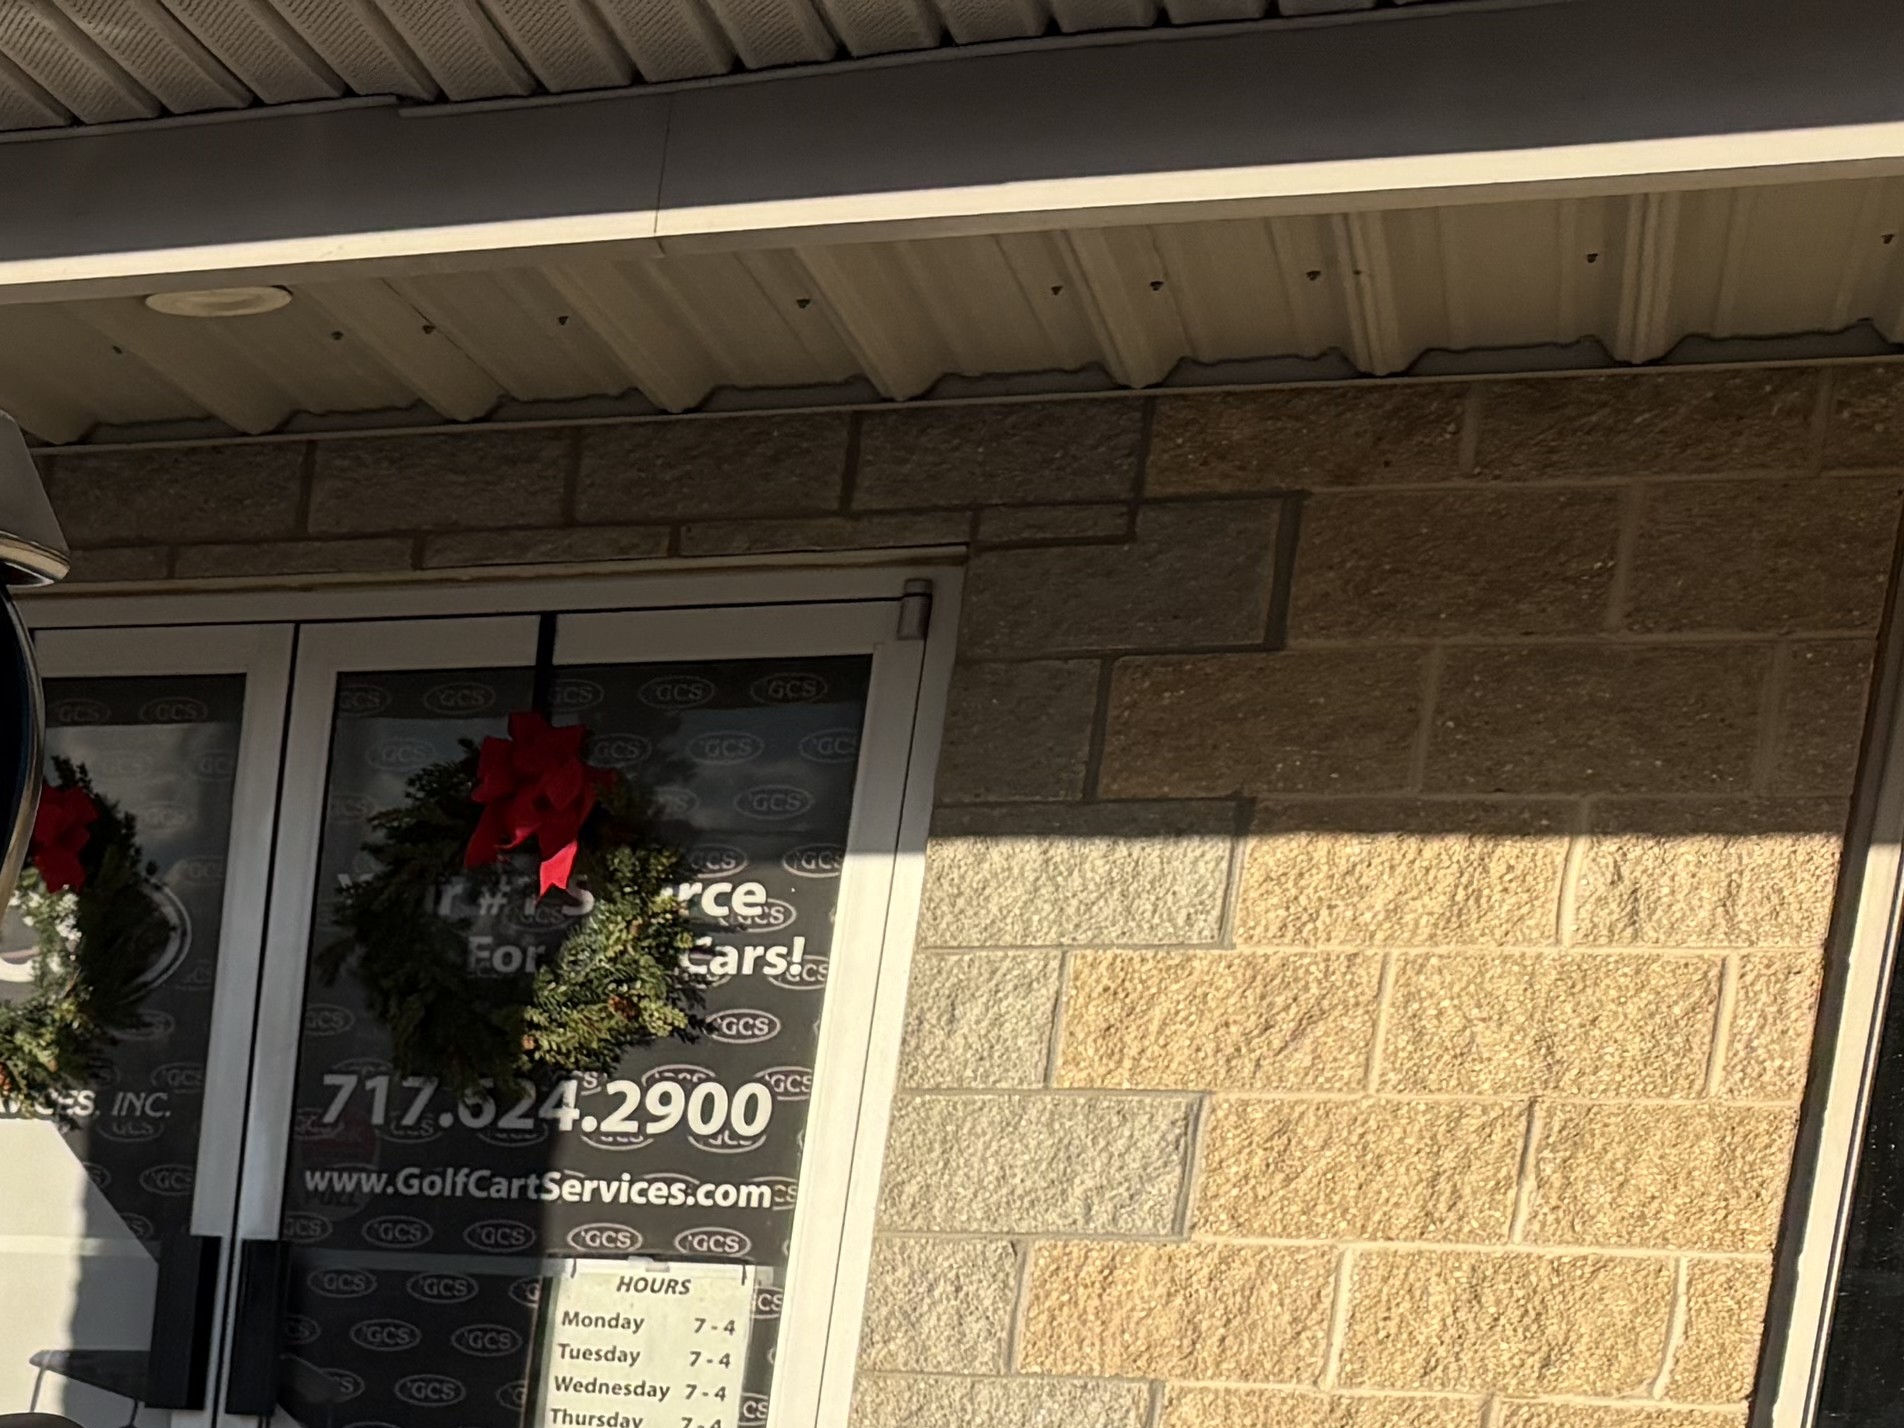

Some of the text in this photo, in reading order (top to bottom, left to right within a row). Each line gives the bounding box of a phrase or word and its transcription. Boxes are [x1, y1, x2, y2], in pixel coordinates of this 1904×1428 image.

[468, 935, 806, 976] For Cars!
[720, 1016, 770, 1036] GCS
[111, 1091, 172, 1118] INC.
[321, 1073, 773, 1137] 717.624.2900
[304, 1166, 772, 1209] www.GolfCartServices.com
[378, 1224, 423, 1241] GCS
[481, 1227, 526, 1245] GCS
[585, 1231, 632, 1249] GCS
[692, 1234, 740, 1253] GCS
[323, 1273, 366, 1291] GCS
[424, 1277, 469, 1296] GCS
[616, 1275, 691, 1296] HOURS
[561, 1311, 644, 1334] Monday
[366, 1325, 412, 1343] GCS
[468, 1330, 512, 1350] GCS
[558, 1343, 640, 1367] Tuesday
[410, 1381, 456, 1400] GCS
[554, 1375, 670, 1402] Wednesday
